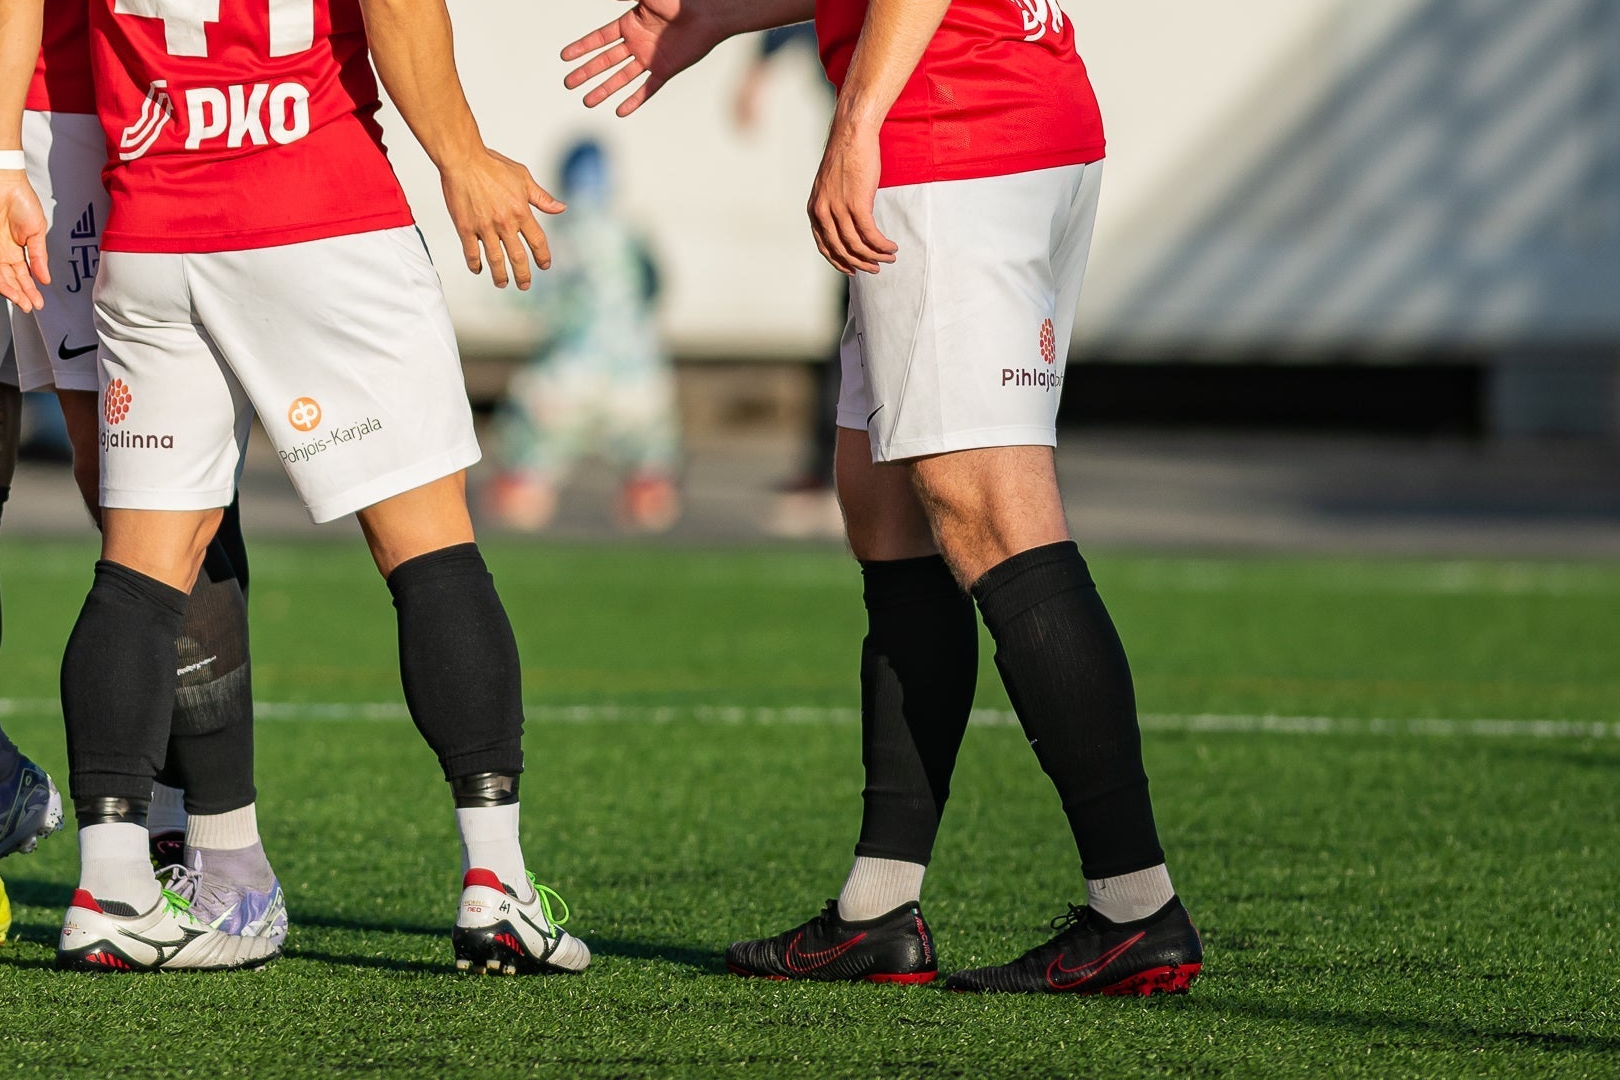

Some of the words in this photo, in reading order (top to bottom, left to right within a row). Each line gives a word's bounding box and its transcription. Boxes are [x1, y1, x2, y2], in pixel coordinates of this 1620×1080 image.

[184, 81, 311, 150] PKO
[1001, 368, 1063, 392] Pihlaja
[100, 428, 174, 453] ajalinna
[279, 417, 383, 465] Pohjois-Karjala
